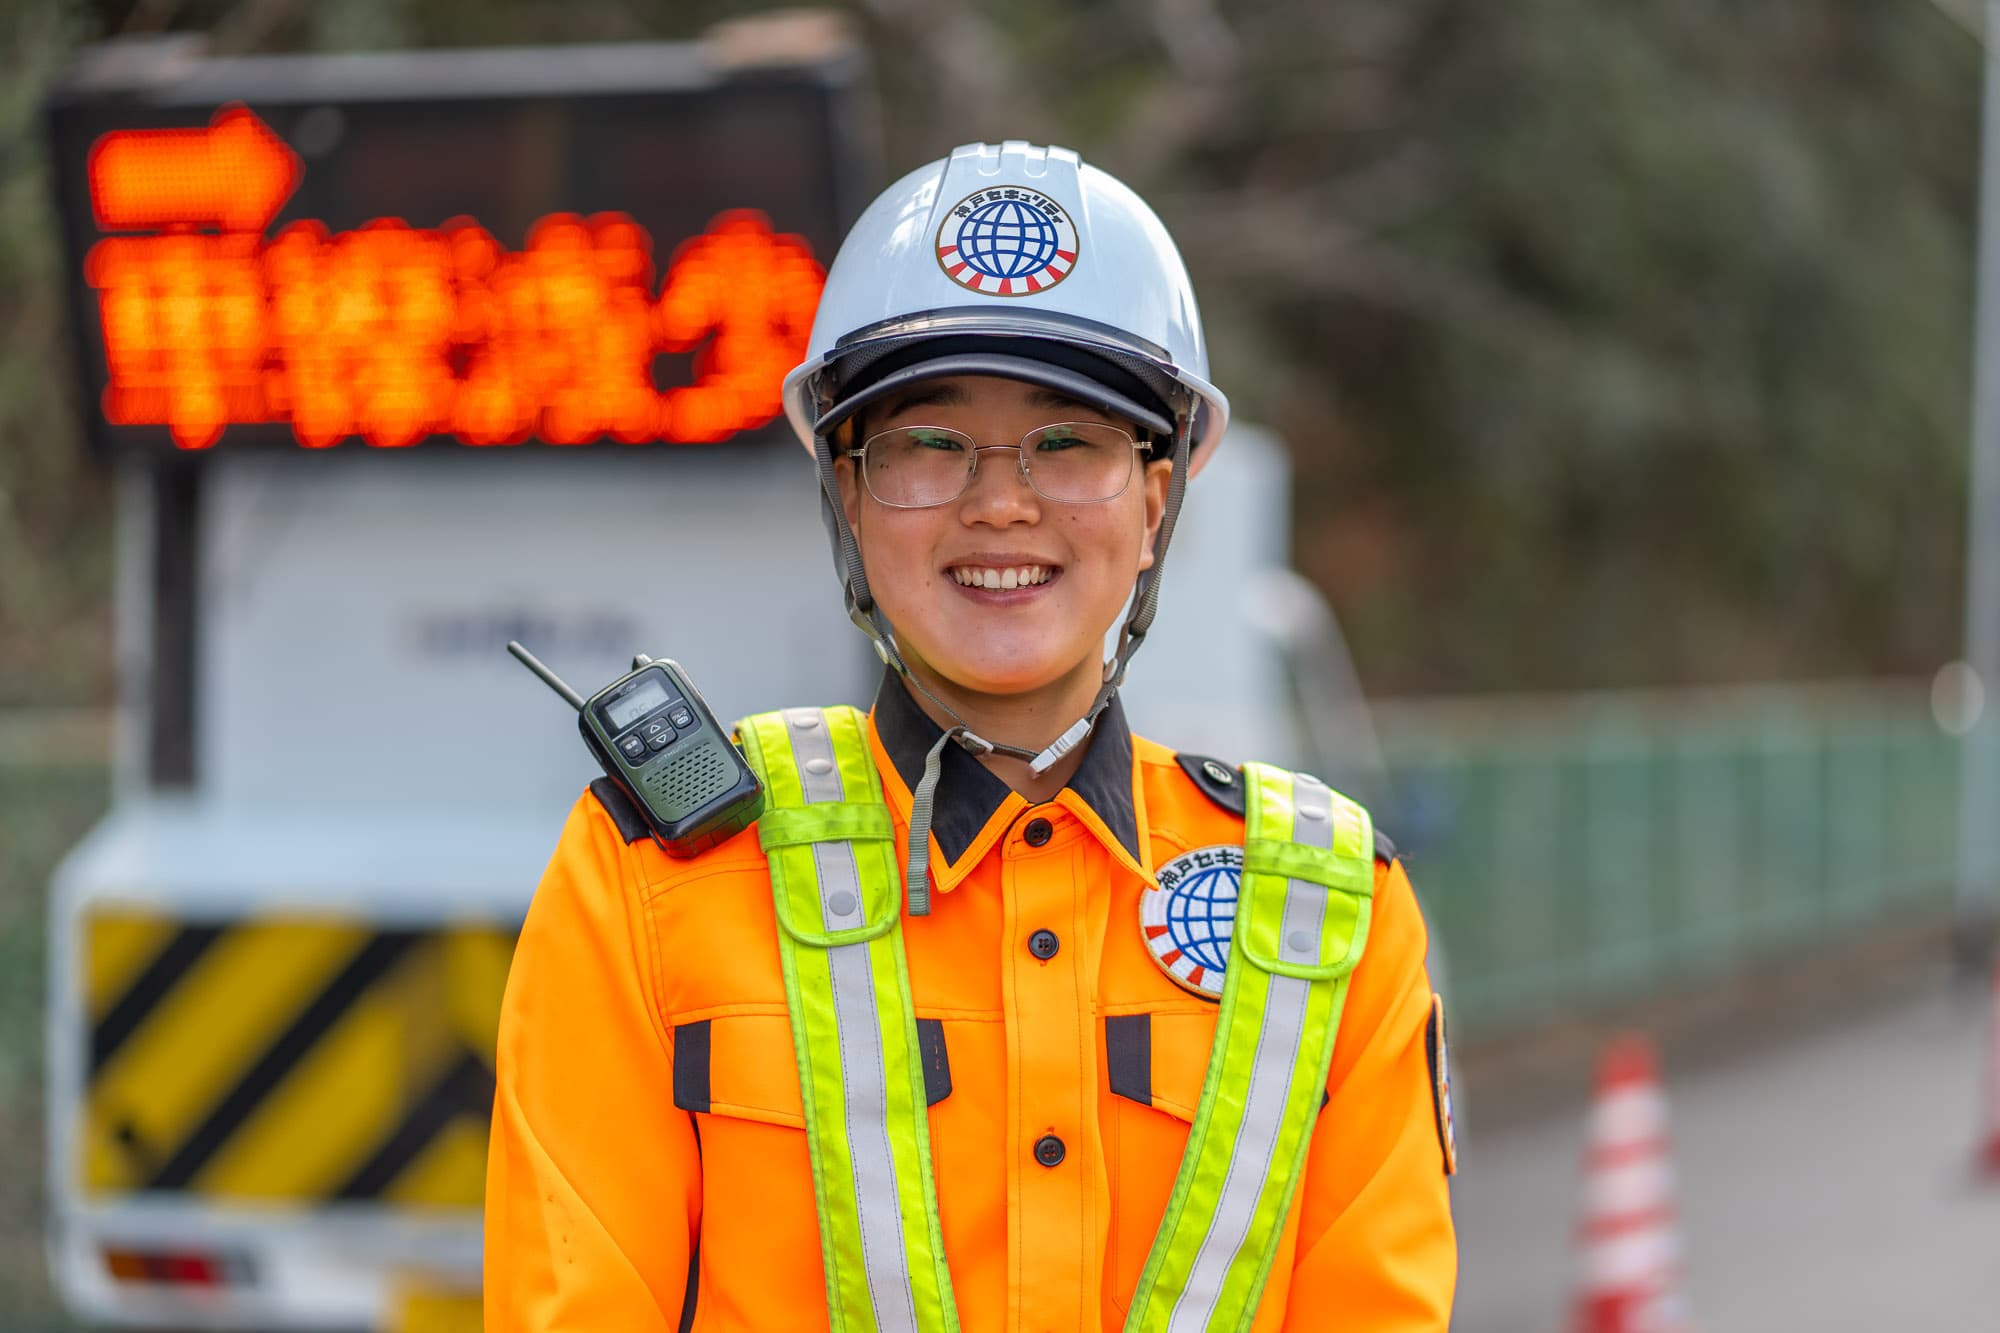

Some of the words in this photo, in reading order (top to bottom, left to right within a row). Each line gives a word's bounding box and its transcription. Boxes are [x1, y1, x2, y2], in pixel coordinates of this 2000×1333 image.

[954, 190, 1064, 223] 神戸セキュリティ
